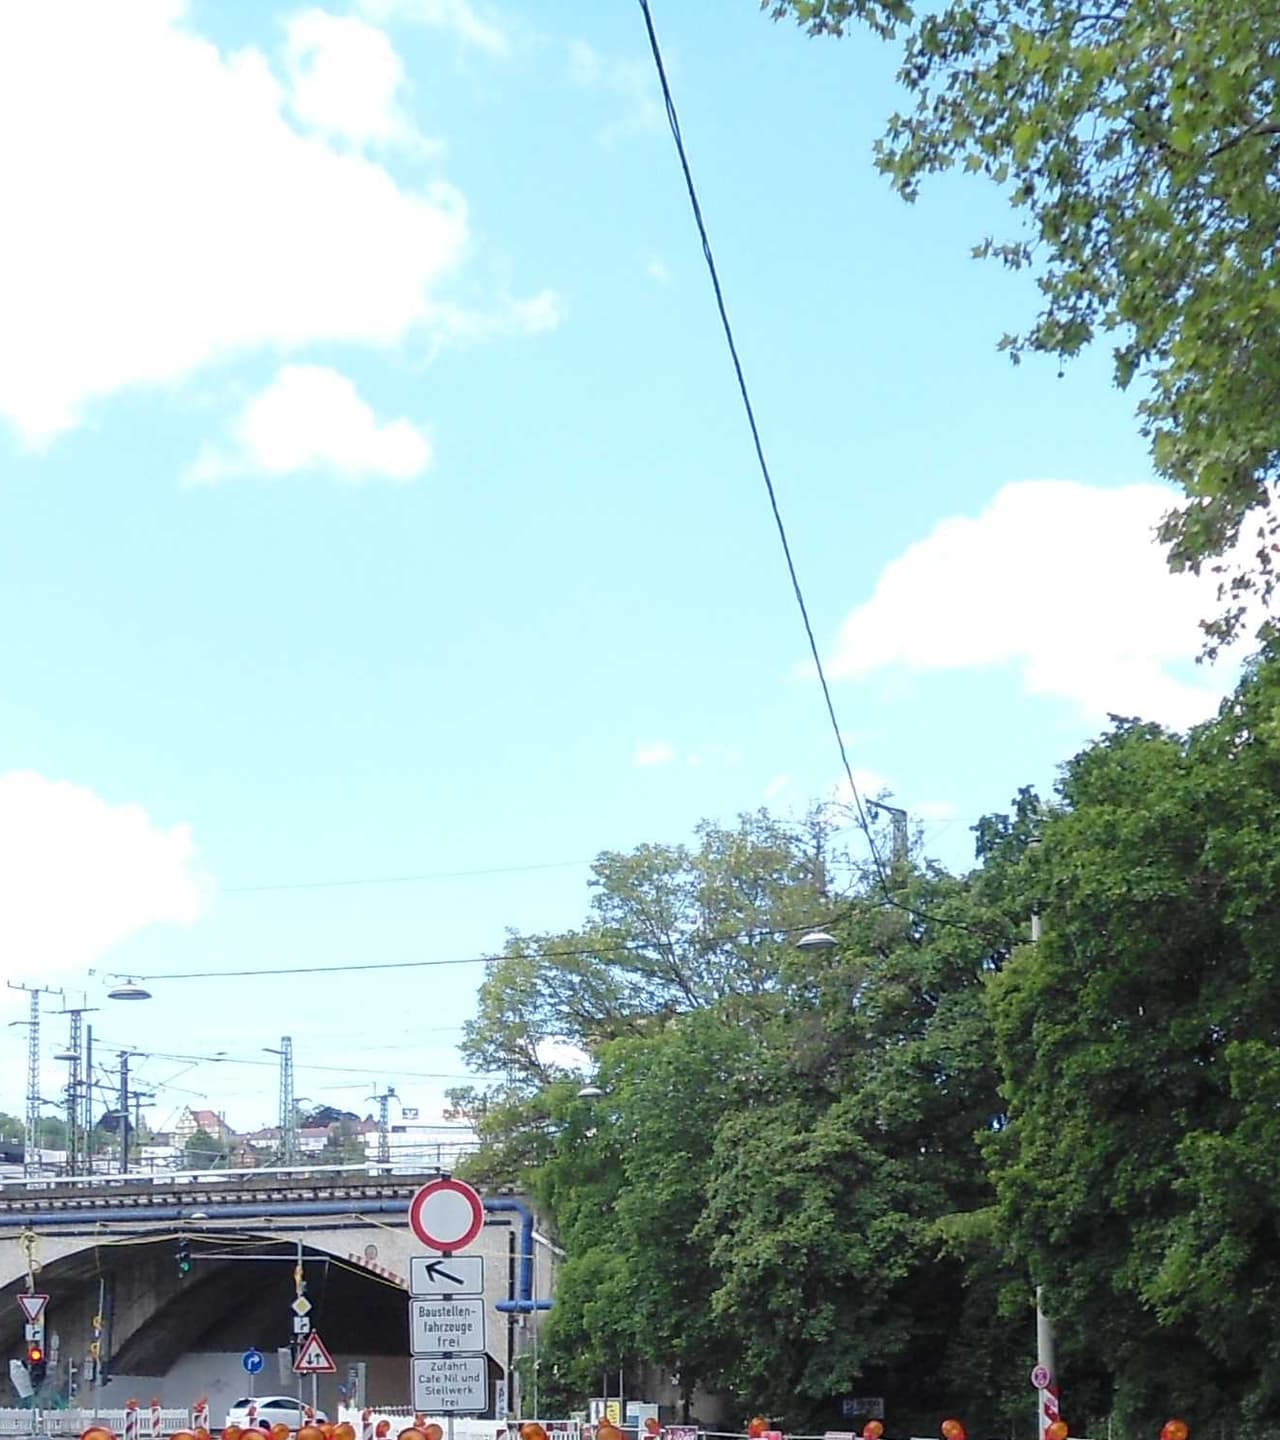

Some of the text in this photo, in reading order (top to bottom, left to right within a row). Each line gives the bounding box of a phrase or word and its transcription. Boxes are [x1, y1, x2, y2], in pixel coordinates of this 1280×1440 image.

[419, 1305, 477, 1318] Baustellen-
[423, 1321, 473, 1335] fahrzeuge
[437, 1335, 460, 1348] frei
[431, 1361, 467, 1371] Zufahrt
[444, 1374, 458, 1382] Nil
[461, 1372, 480, 1383] und
[424, 1385, 473, 1396] Stellwerk
[441, 1397, 460, 1407] frei
